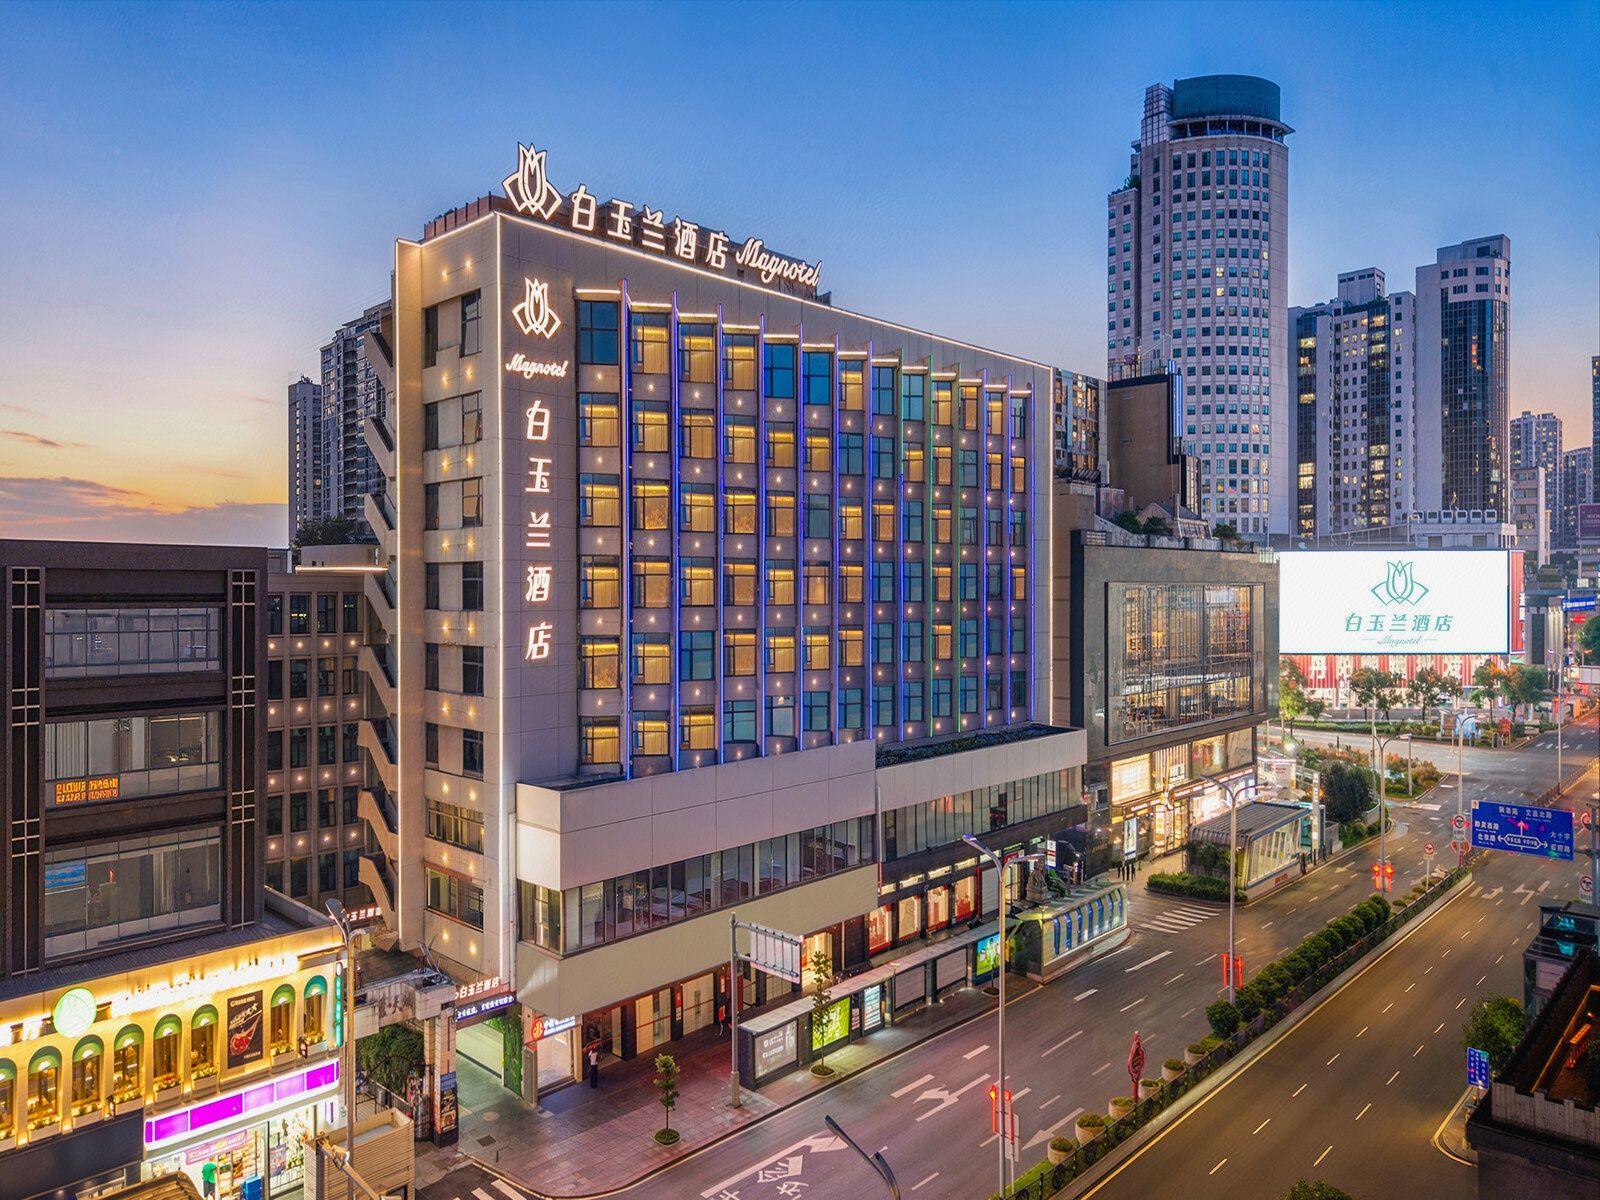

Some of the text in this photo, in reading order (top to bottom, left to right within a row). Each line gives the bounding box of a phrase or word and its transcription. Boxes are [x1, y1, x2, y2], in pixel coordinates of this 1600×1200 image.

[572, 184, 823, 287] 白玉兰酒店 Magnotel
[506, 352, 568, 377] Magnotel
[525, 400, 552, 660] 白玉兰酒店
[1345, 612, 1453, 632] 白玉兰酒店
[1377, 635, 1422, 647] Magnotel
